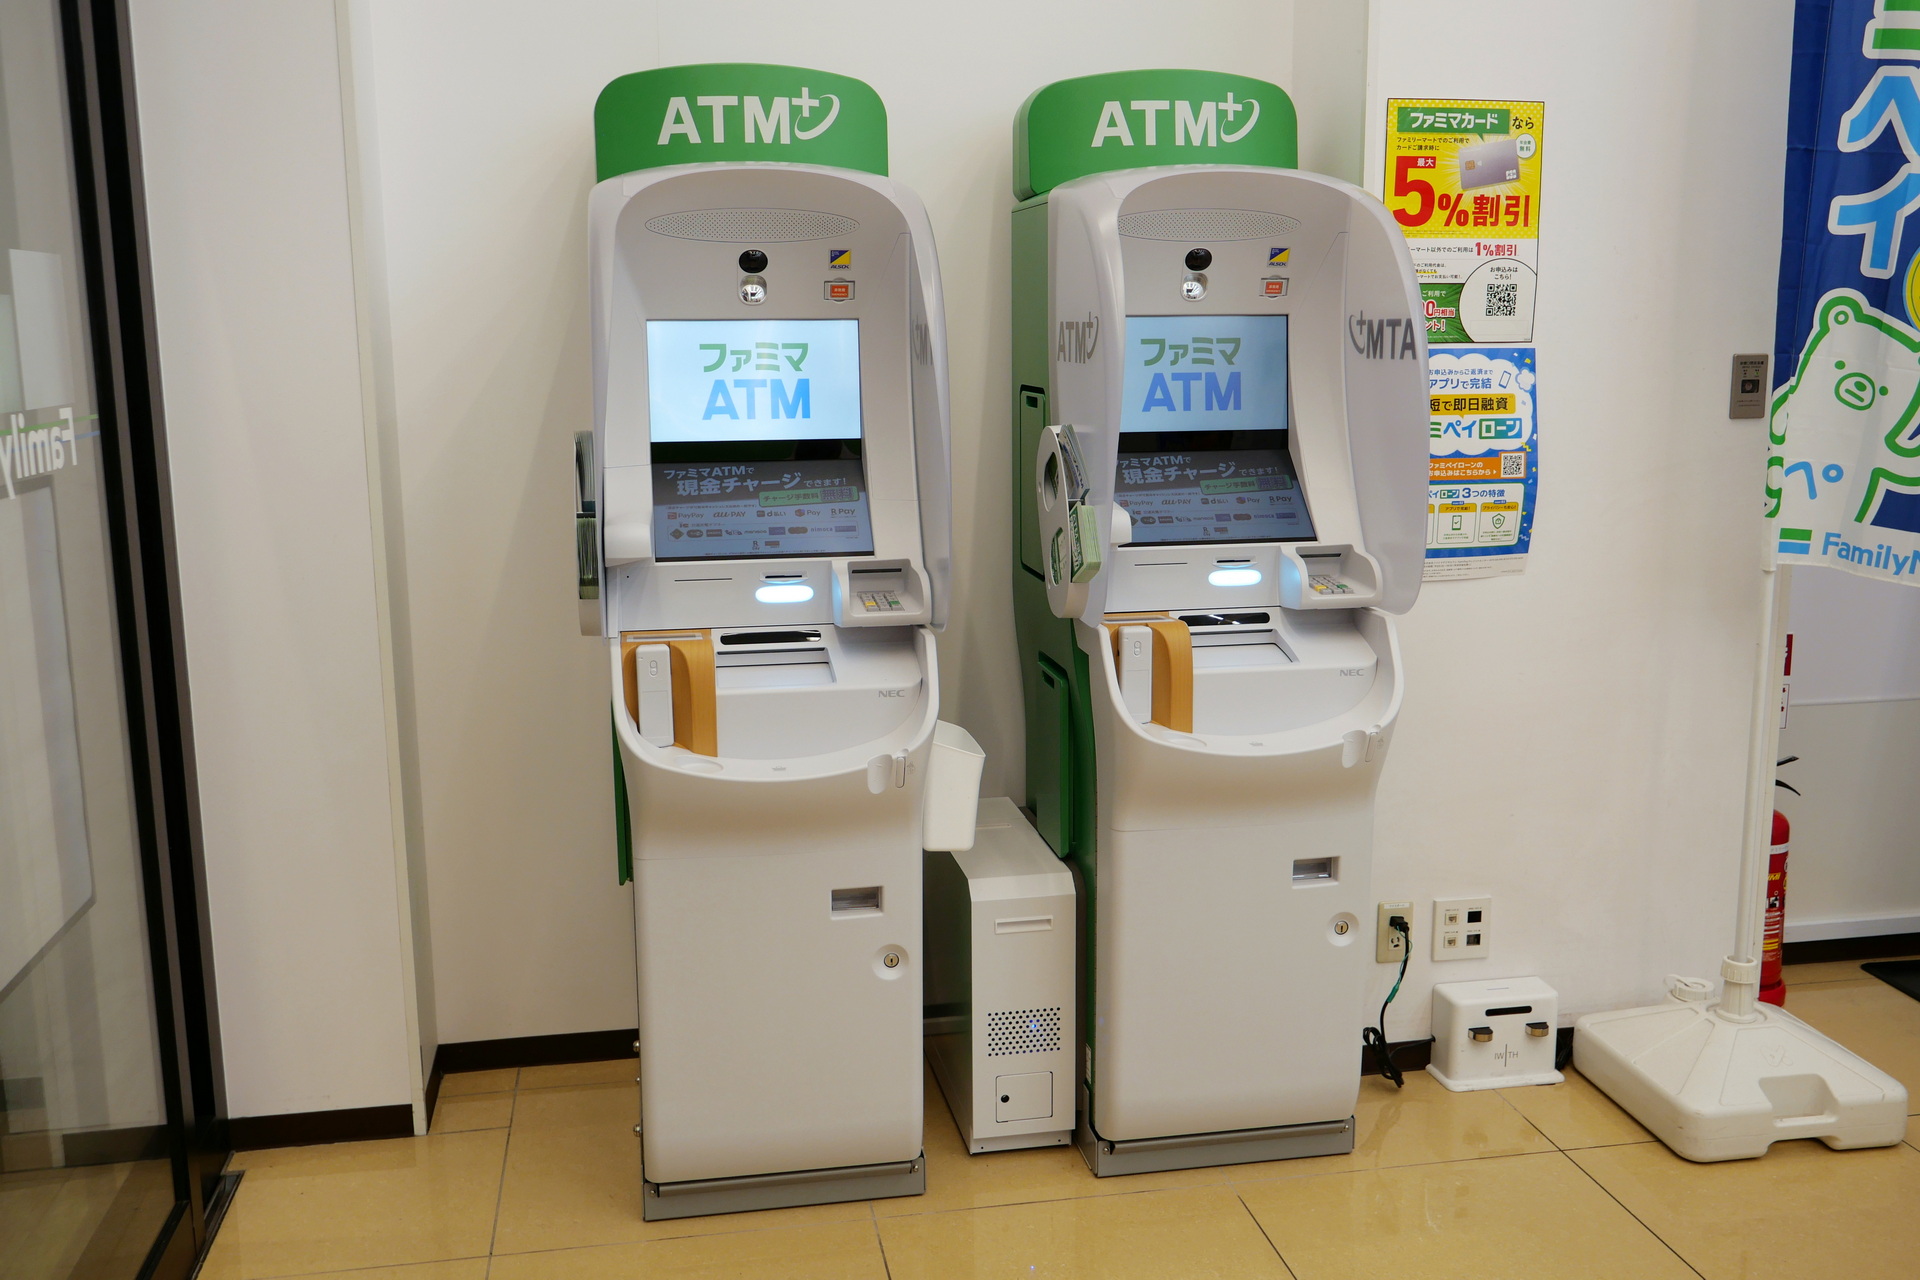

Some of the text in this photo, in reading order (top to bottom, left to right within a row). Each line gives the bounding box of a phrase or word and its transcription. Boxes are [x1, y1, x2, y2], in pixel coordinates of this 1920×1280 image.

[1410, 112, 1534, 129] ファミマカード なら
[1417, 158, 1434, 167] 最大
[1475, 242, 1517, 256] 1%割引
[1422, 300, 1455, 317] 0円相当
[699, 342, 809, 372] ファミマ
[1140, 337, 1241, 366] ファミマ
[1430, 378, 1492, 389] アプリで完結
[702, 378, 811, 420] ATM
[1141, 371, 1242, 412] ATM
[1118, 455, 1191, 468] ァミマATMで
[664, 466, 754, 479] ファミマATMで
[1122, 462, 1235, 485] 現金チャージ
[676, 472, 801, 496] 現金チャージ
[1462, 487, 1506, 498] 3つの特徴
[1339, 668, 1365, 677] NEC
[878, 689, 905, 698] NEC
